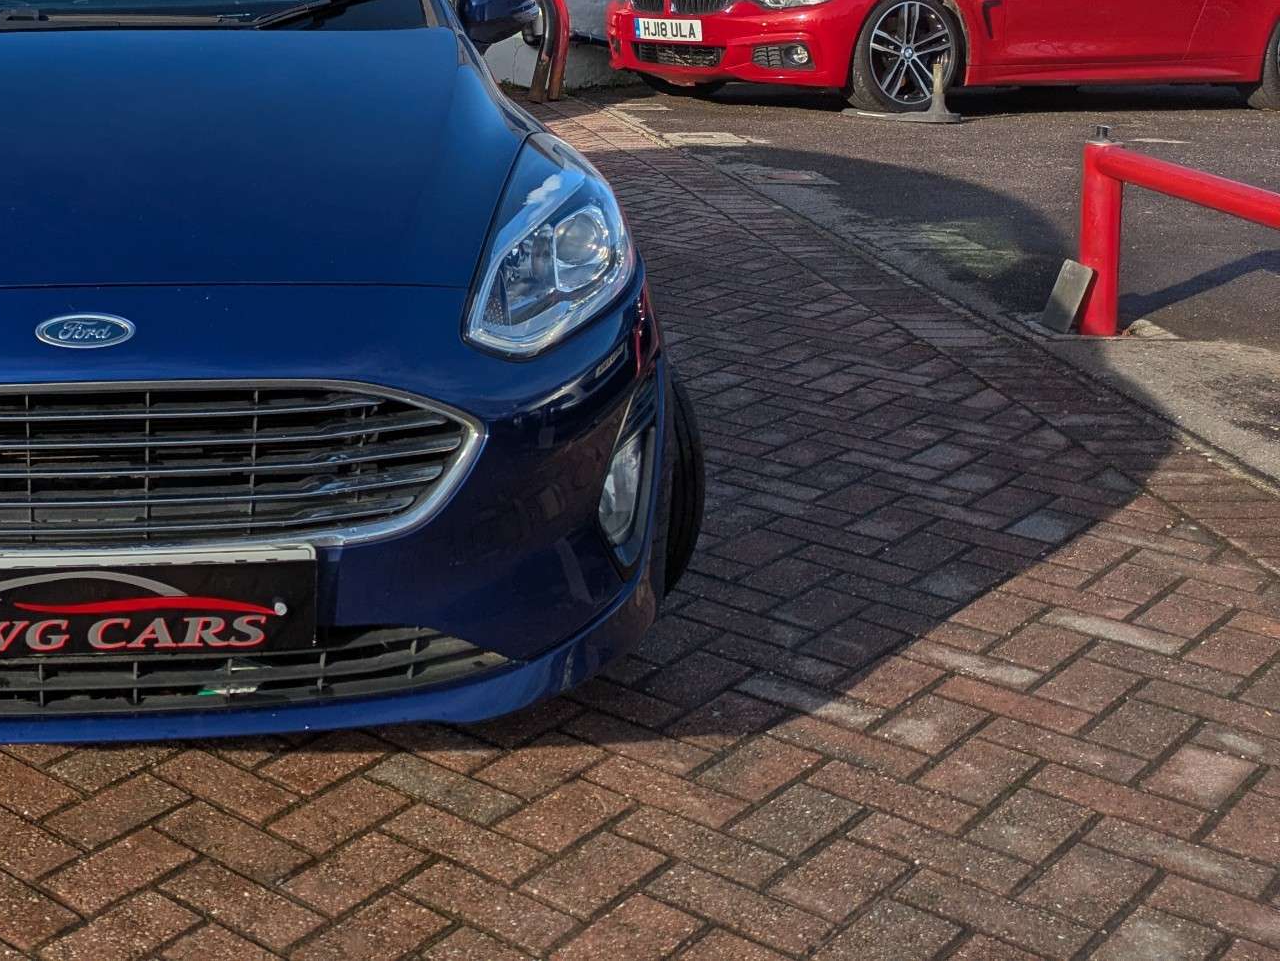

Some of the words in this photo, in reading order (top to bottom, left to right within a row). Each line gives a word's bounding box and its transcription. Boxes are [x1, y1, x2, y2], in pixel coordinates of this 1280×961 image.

[643, 20, 667, 37] HJ18
[670, 22, 697, 38] ULA
[58, 320, 112, 340] Ford
[87, 614, 268, 650] CARS
